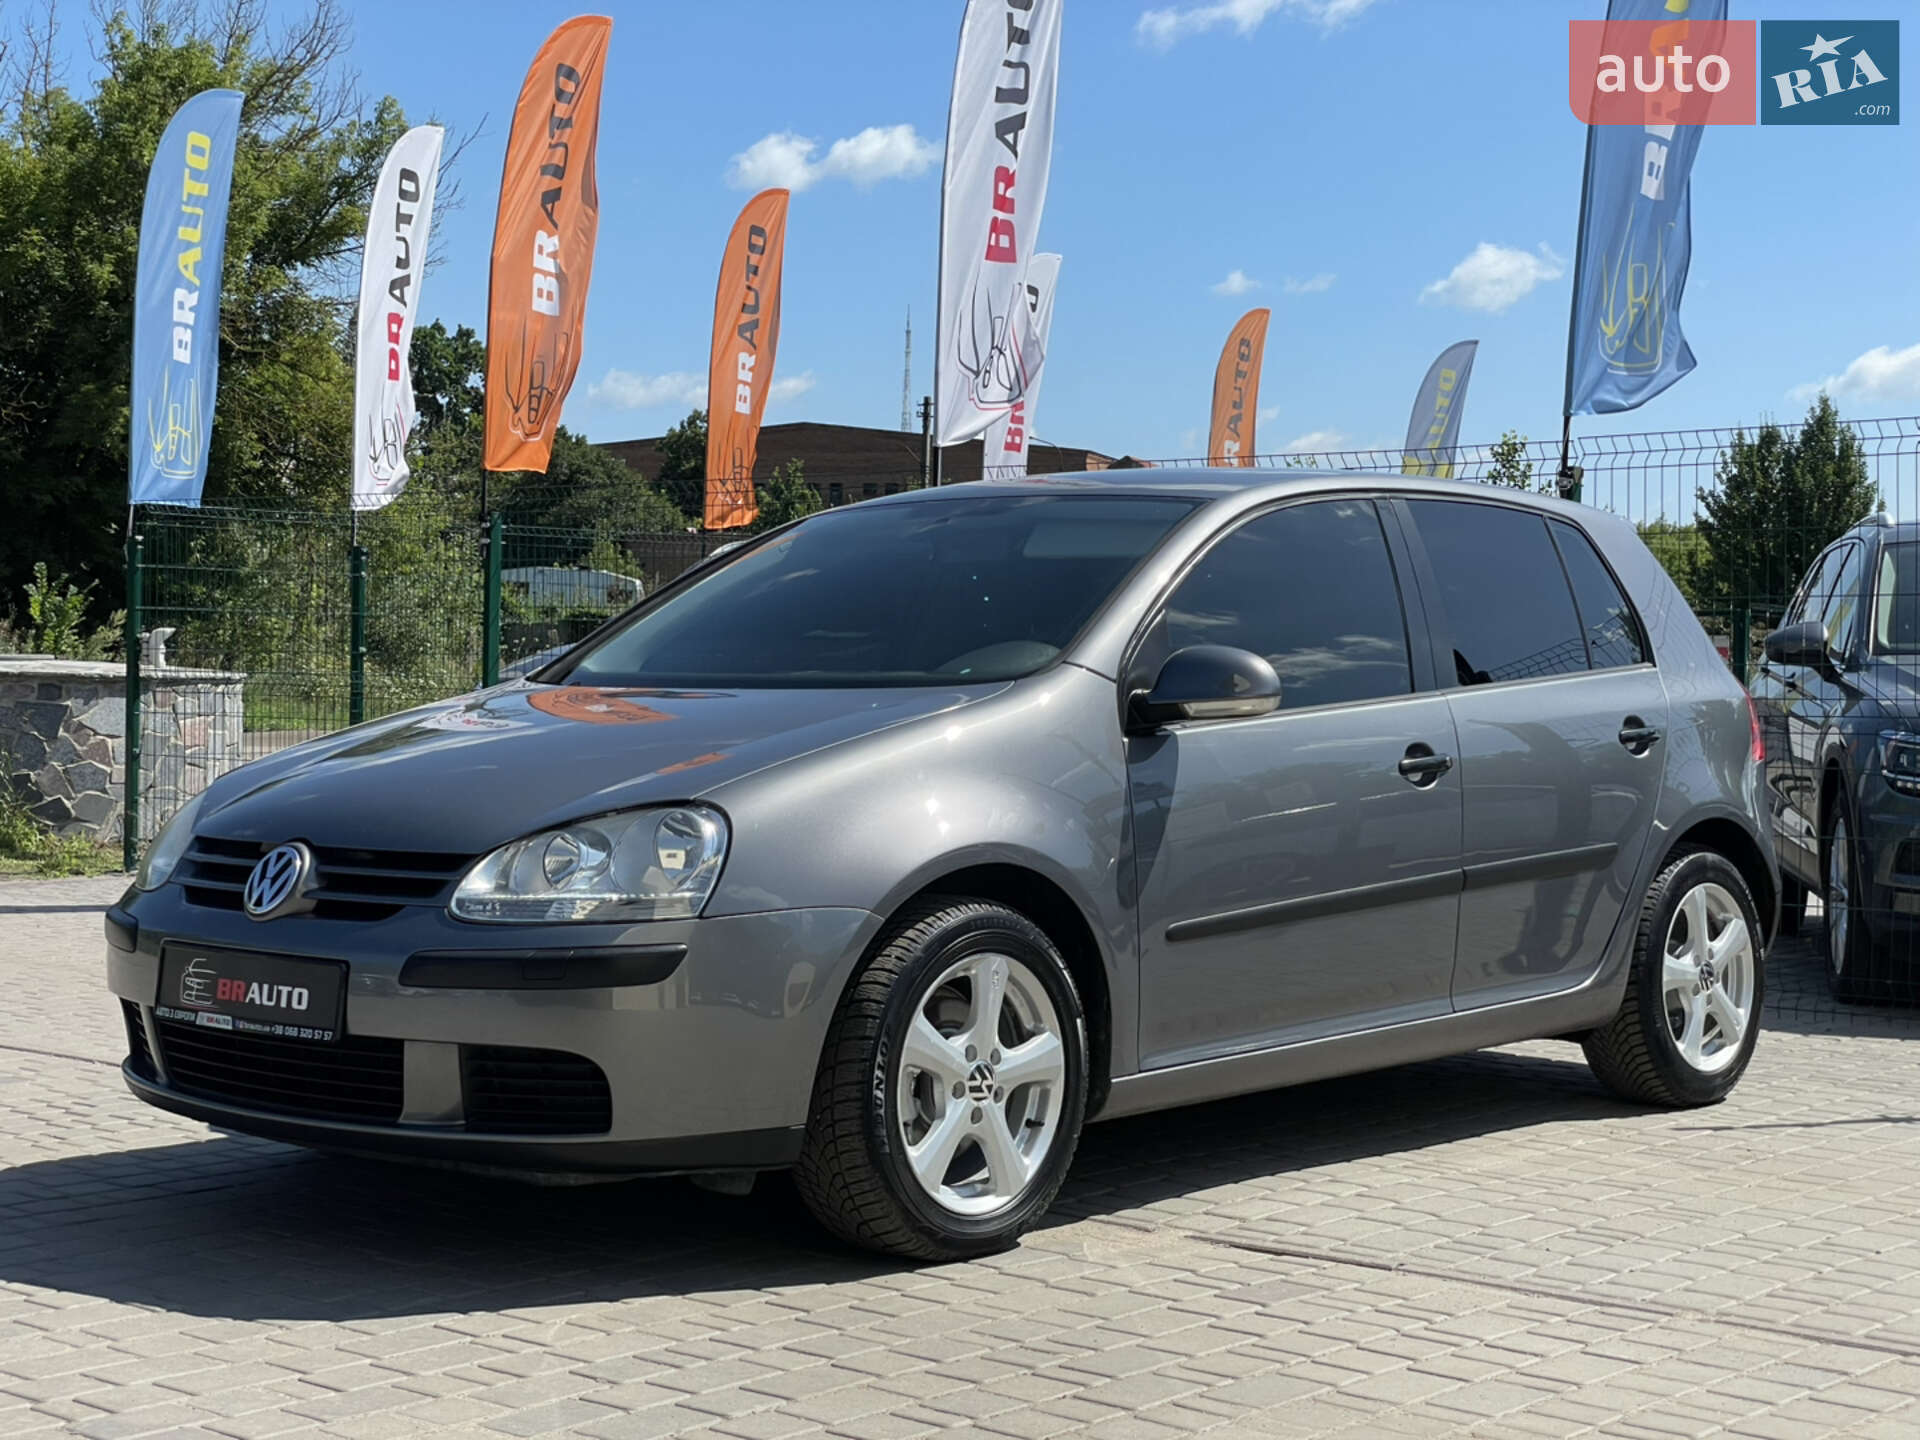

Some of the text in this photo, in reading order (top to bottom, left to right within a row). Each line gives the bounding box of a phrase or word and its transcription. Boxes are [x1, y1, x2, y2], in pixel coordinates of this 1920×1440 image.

[173, 131, 212, 364] BRAUTO
[531, 62, 582, 317] BRAUTO
[734, 224, 768, 416] BRAUTO
[1223, 336, 1252, 467] RAUTO
[217, 978, 309, 1010] BRAUTO
